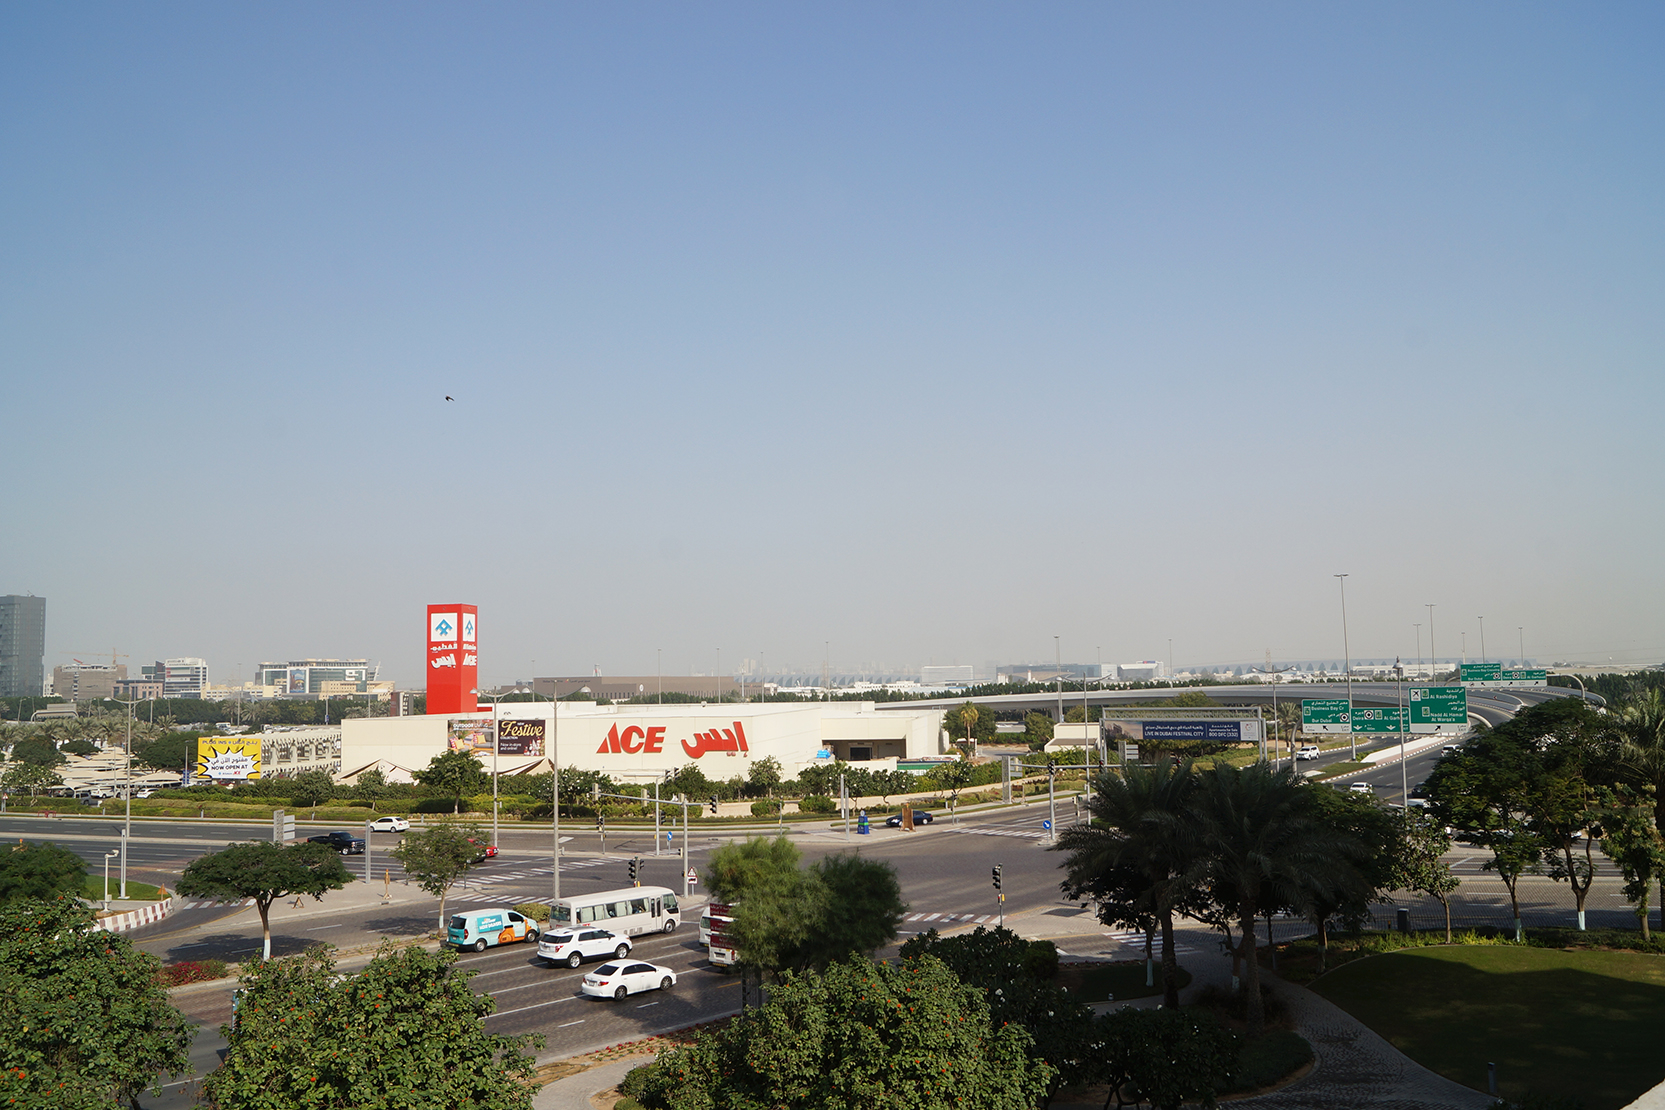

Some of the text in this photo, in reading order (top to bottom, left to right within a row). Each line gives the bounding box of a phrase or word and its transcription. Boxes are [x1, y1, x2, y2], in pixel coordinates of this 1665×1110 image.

[431, 653, 456, 668] إيس
[501, 720, 543, 737] Festive
[596, 722, 667, 754] ACE
[680, 721, 749, 759] إيس
